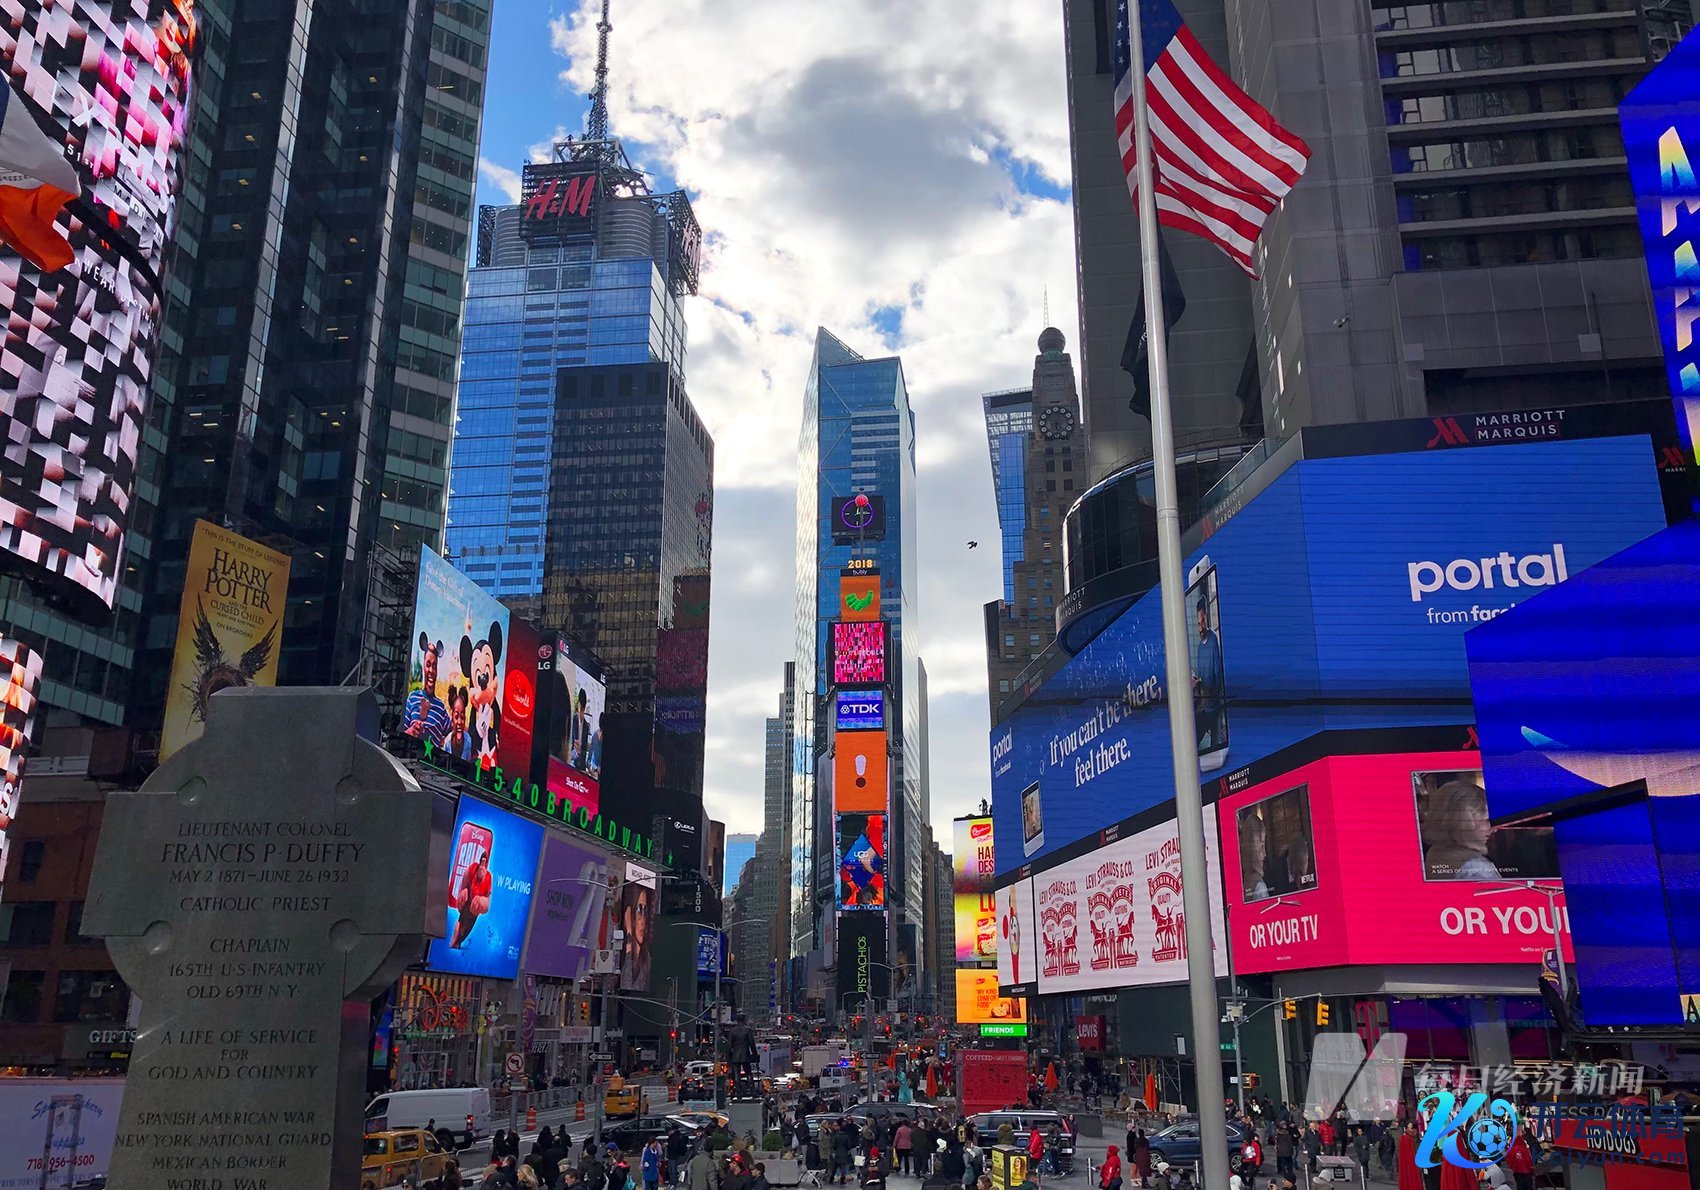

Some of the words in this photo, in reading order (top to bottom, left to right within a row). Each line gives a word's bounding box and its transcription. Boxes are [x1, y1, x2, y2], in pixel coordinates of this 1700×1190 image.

[525, 175, 596, 221] H&M
[1476, 410, 1565, 426] MARRIOTT
[1478, 423, 1558, 440] MARQUIS
[1214, 486, 1244, 516] MARRIOTT
[1215, 501, 1242, 529] MARQUIS
[212, 547, 273, 591] HARRY
[848, 559, 873, 569] 2018
[1408, 543, 1568, 602] portal
[205, 567, 273, 615] POTTER
[210, 599, 240, 616] CURSED
[241, 610, 265, 626] CHILD
[1427, 607, 1468, 624] from
[538, 661, 551, 670] LG
[849, 704, 879, 714] TDK
[1050, 736, 1058, 766] If
[1059, 730, 1077, 768] you
[1078, 714, 1104, 746] can't
[1106, 699, 1120, 729] be
[1122, 674, 1162, 718] there,
[993, 727, 1013, 767] portal
[1075, 757, 1095, 788] feel
[1097, 737, 1131, 773] there.
[1229, 767, 1250, 781] MARRIOTT
[1229, 779, 1249, 791] MARQUIS
[178, 822, 270, 837] LIEUTENANT
[276, 822, 352, 837] COLONEL
[547, 791, 653, 855] BROADWAY
[162, 843, 256, 864] FRANCIS
[1145, 851, 1159, 870] LEVI
[169, 870, 201, 883] MAY
[205, 870, 214, 882] 2
[297, 870, 313, 883] 26
[317, 870, 350, 883] 1932
[1085, 873, 1097, 889] LEVI
[1097, 861, 1119, 884] STRAUSS
[179, 897, 263, 912] CATHOLIC
[272, 897, 332, 912] PRIEST
[1440, 907, 1488, 935] OR
[1250, 924, 1267, 949] OR
[1266, 918, 1300, 946] YOUR
[1301, 914, 1318, 941] TV
[210, 938, 290, 953] CHAPLAIN
[169, 963, 213, 977] 165TH
[857, 936, 867, 993] PISTACHIOS
[186, 985, 220, 998] OLD
[225, 985, 263, 998] 69TH
[89, 1030, 138, 1044] GIFTS
[160, 1030, 173, 1045] A
[180, 1030, 213, 1045] LIFE
[220, 1030, 241, 1045] OF
[250, 1030, 317, 1045] SERVICE
[220, 1049, 249, 1061] FOR
[148, 1066, 188, 1080] GOD
[193, 1066, 230, 1080] AND
[237, 1066, 318, 1080] COUNTRY
[137, 1111, 196, 1125] SPANISH
[199, 1111, 278, 1125] AMERICAN
[282, 1111, 316, 1125] WAR
[114, 1133, 149, 1148] NEW
[153, 1133, 192, 1148] YORK
[199, 1133, 273, 1148] NATIONAL
[278, 1133, 332, 1148] GUARD
[153, 1156, 223, 1170] MEXICAN
[226, 1156, 287, 1170] BORDER
[167, 1178, 224, 1190] WORLD
[234, 1178, 268, 1190] WAR
